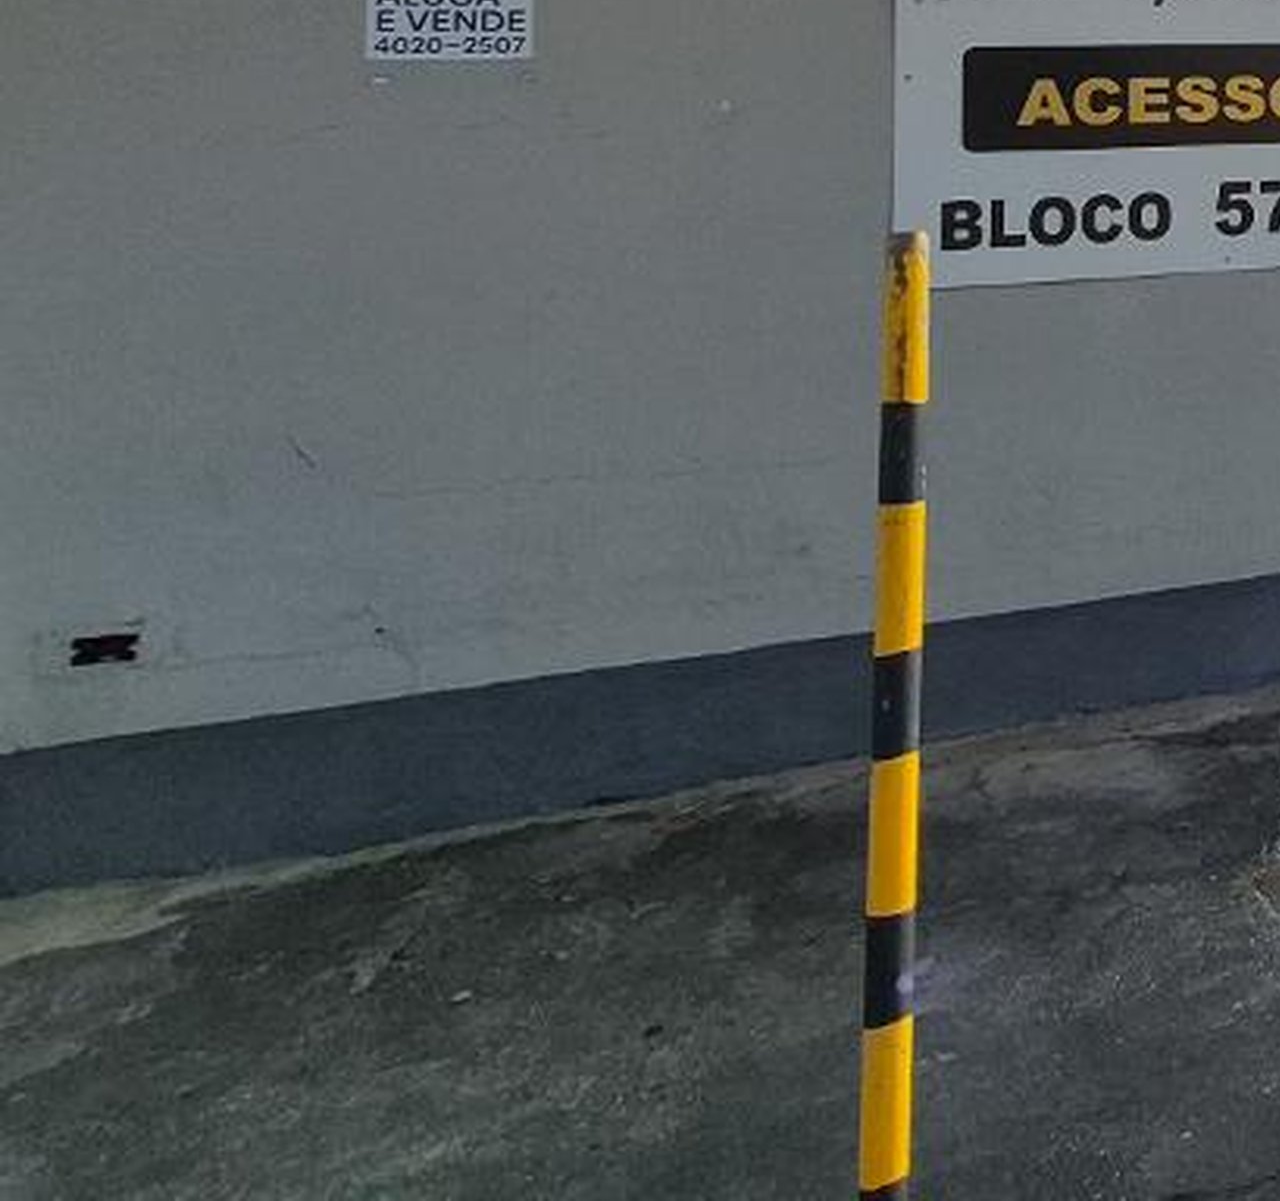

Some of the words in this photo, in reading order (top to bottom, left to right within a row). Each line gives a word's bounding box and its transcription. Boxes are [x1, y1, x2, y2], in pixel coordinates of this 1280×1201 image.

[376, 9, 395, 32] E
[406, 9, 526, 32] VENDE
[374, 36, 526, 55] 4020-2507
[940, 191, 1173, 252] BLOCO
